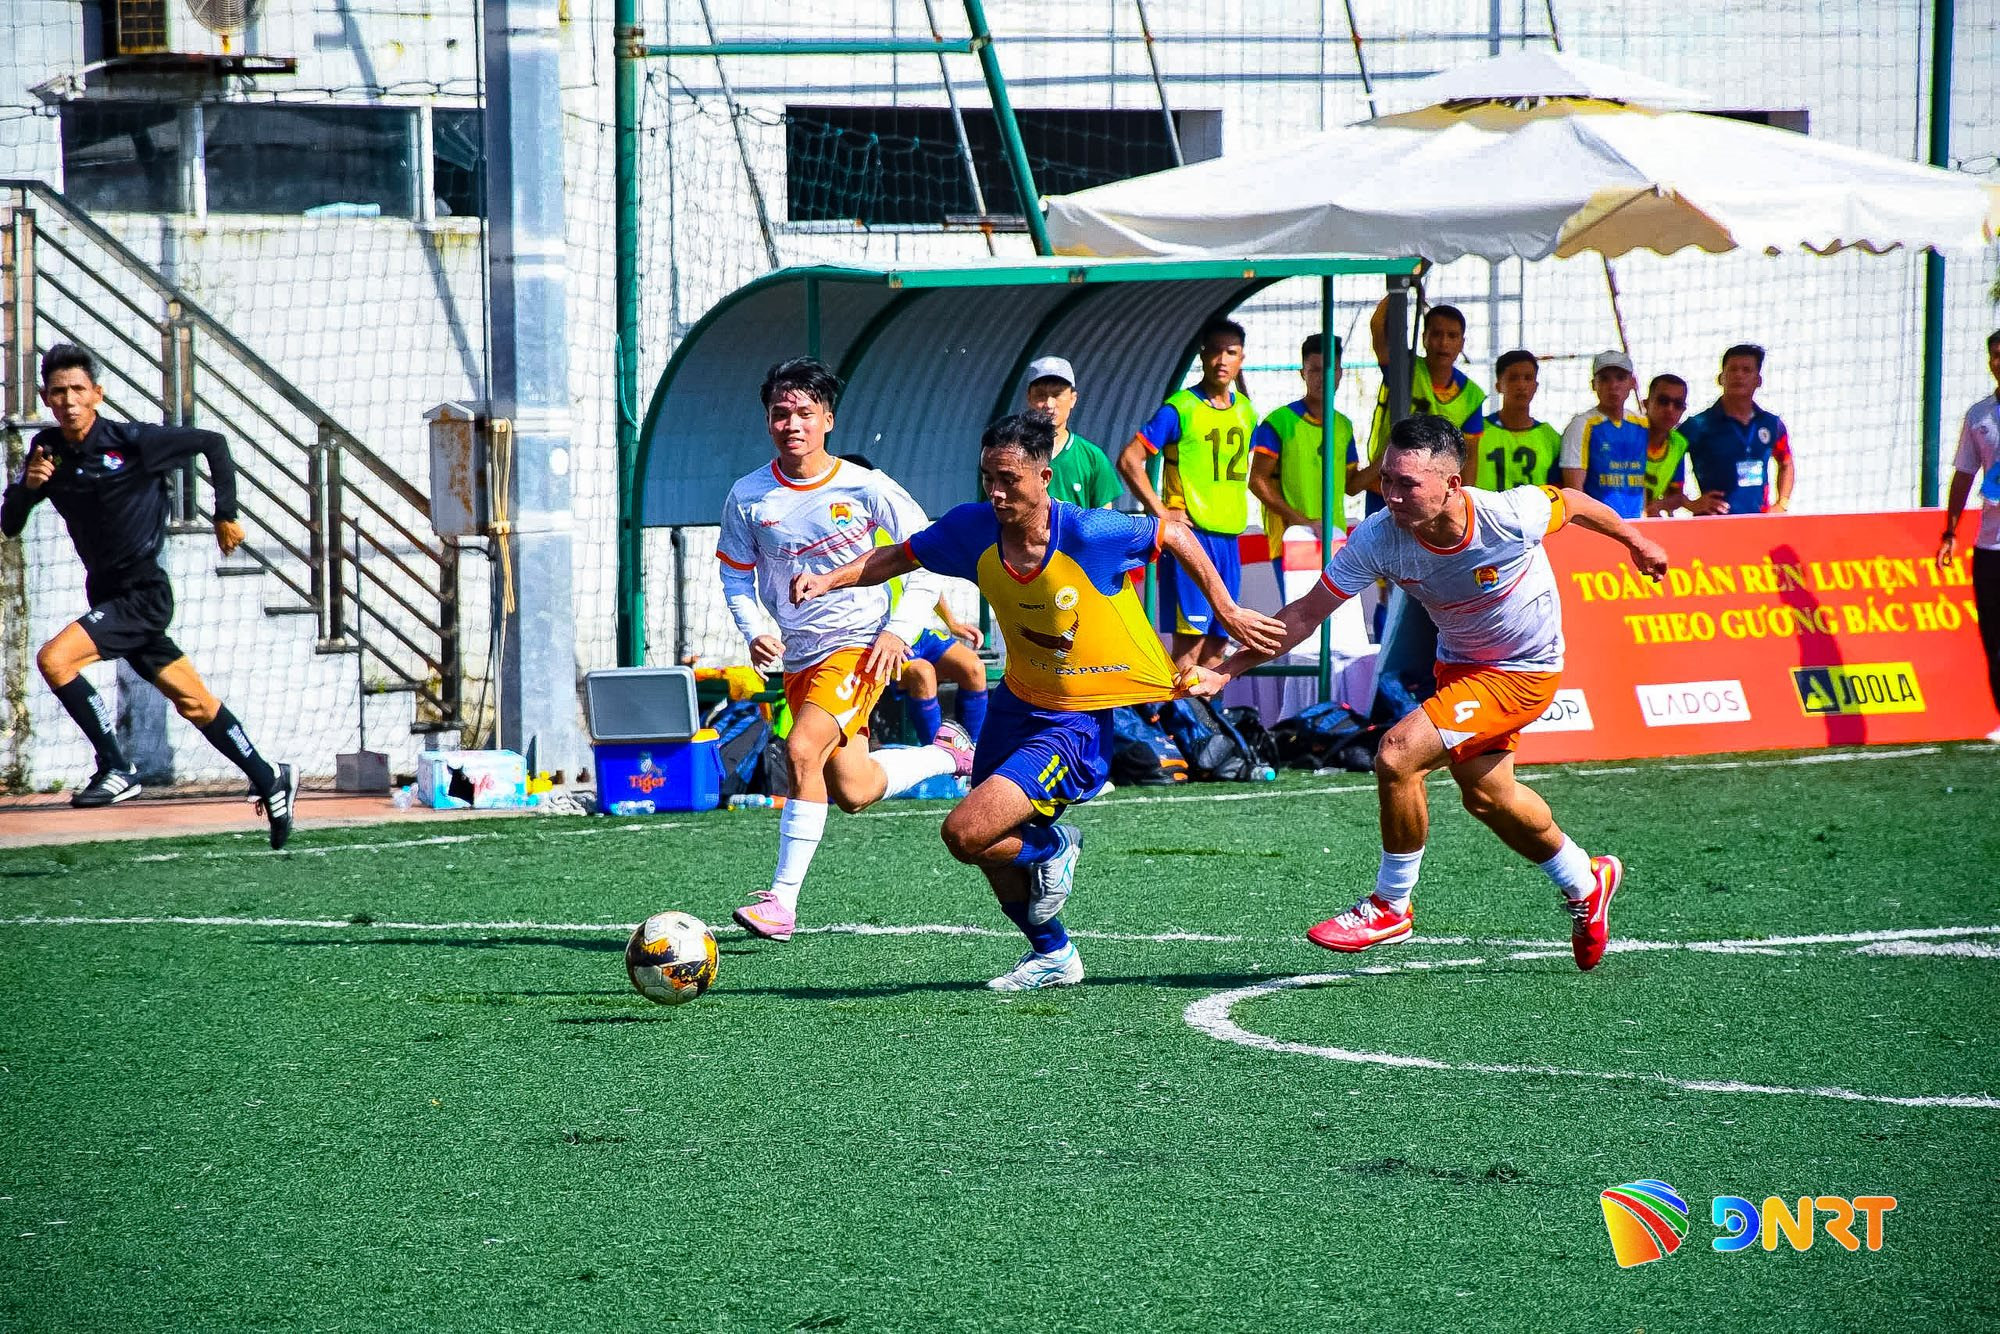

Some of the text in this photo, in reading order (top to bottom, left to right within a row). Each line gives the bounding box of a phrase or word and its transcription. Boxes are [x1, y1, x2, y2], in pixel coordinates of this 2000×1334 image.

[1204, 426, 1247, 481] 12
[1486, 446, 1537, 492] 13
[1571, 562, 1665, 601] TOÀN
[1668, 557, 1737, 597] DÂN
[1740, 555, 1805, 593] RÈN
[1809, 555, 1919, 595] LUYỆN
[1624, 611, 1716, 644] THEO
[1720, 603, 1840, 639] GƯƠNG
[1842, 595, 1909, 635] BÁC
[1054, 663, 1130, 675] EXPRESS
[1838, 672, 1916, 704] JOOLA
[1647, 690, 1740, 716] LADOS
[629, 773, 667, 793] Tiger
[1037, 754, 1069, 792] 11
